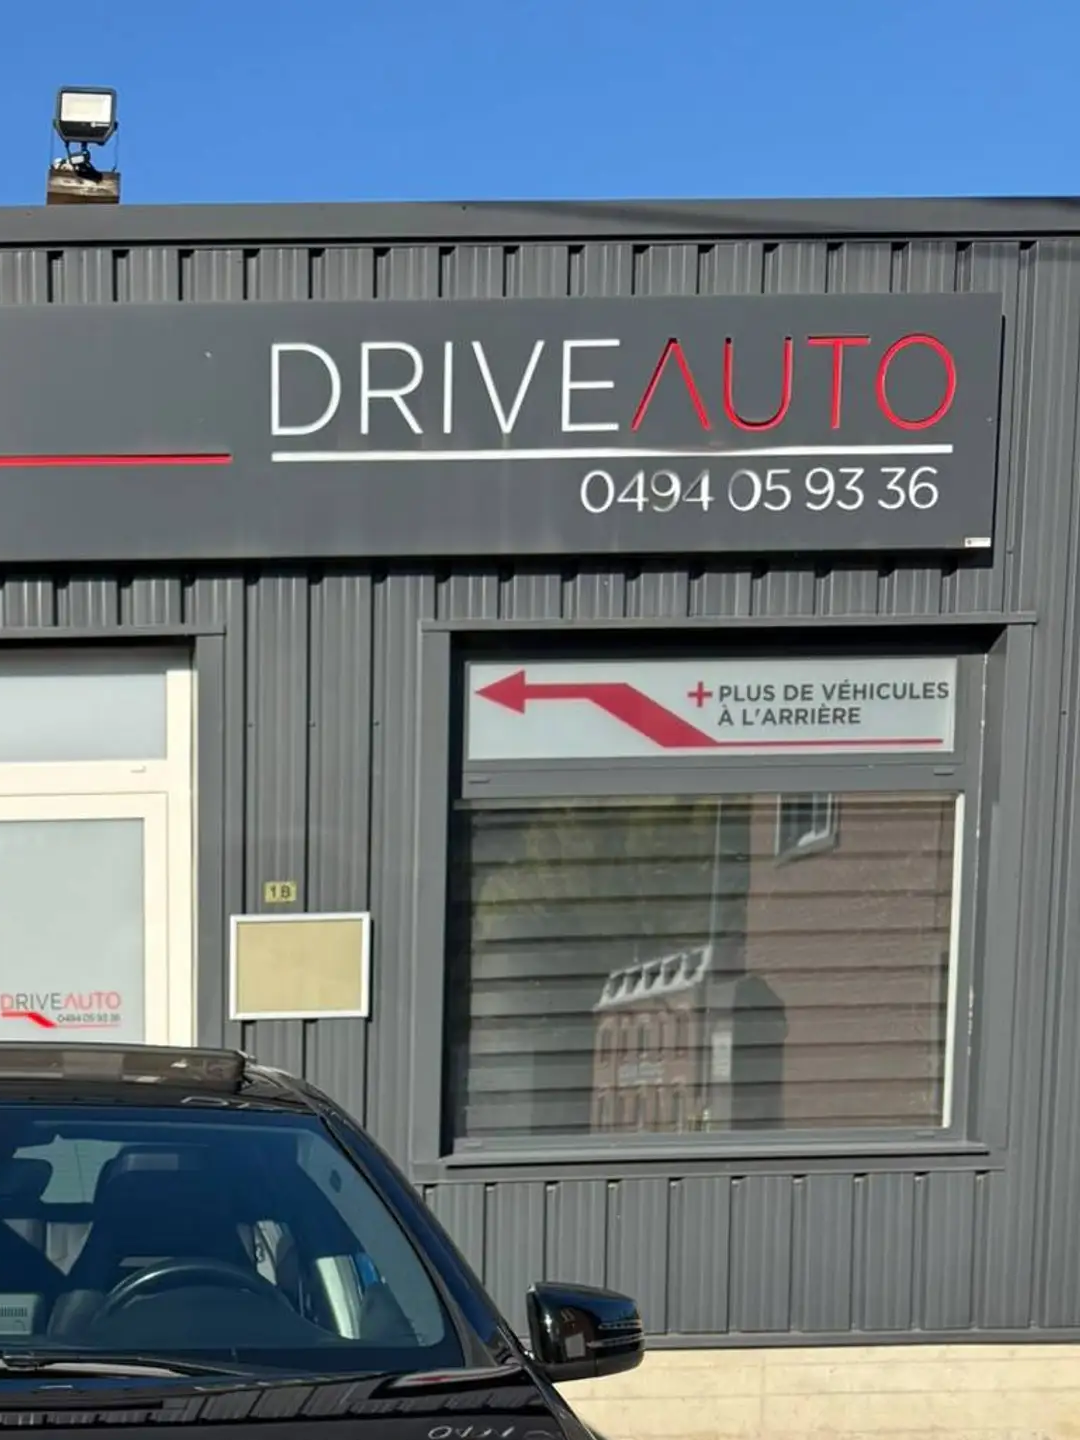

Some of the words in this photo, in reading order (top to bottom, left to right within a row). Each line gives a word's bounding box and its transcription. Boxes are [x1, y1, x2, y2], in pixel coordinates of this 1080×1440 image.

[271, 333, 957, 437] DRIVEAUTO
[580, 469, 713, 513] 0494
[727, 469, 792, 511] 05
[804, 467, 864, 510] 93
[877, 466, 939, 509] 36
[719, 684, 776, 702] PLUS
[783, 684, 815, 701] DE
[822, 680, 950, 701] VÉHICULES
[718, 704, 734, 727] À
[742, 704, 862, 726] L'ARRIÈRE
[0, 991, 123, 1011] DRIVEAUTO
